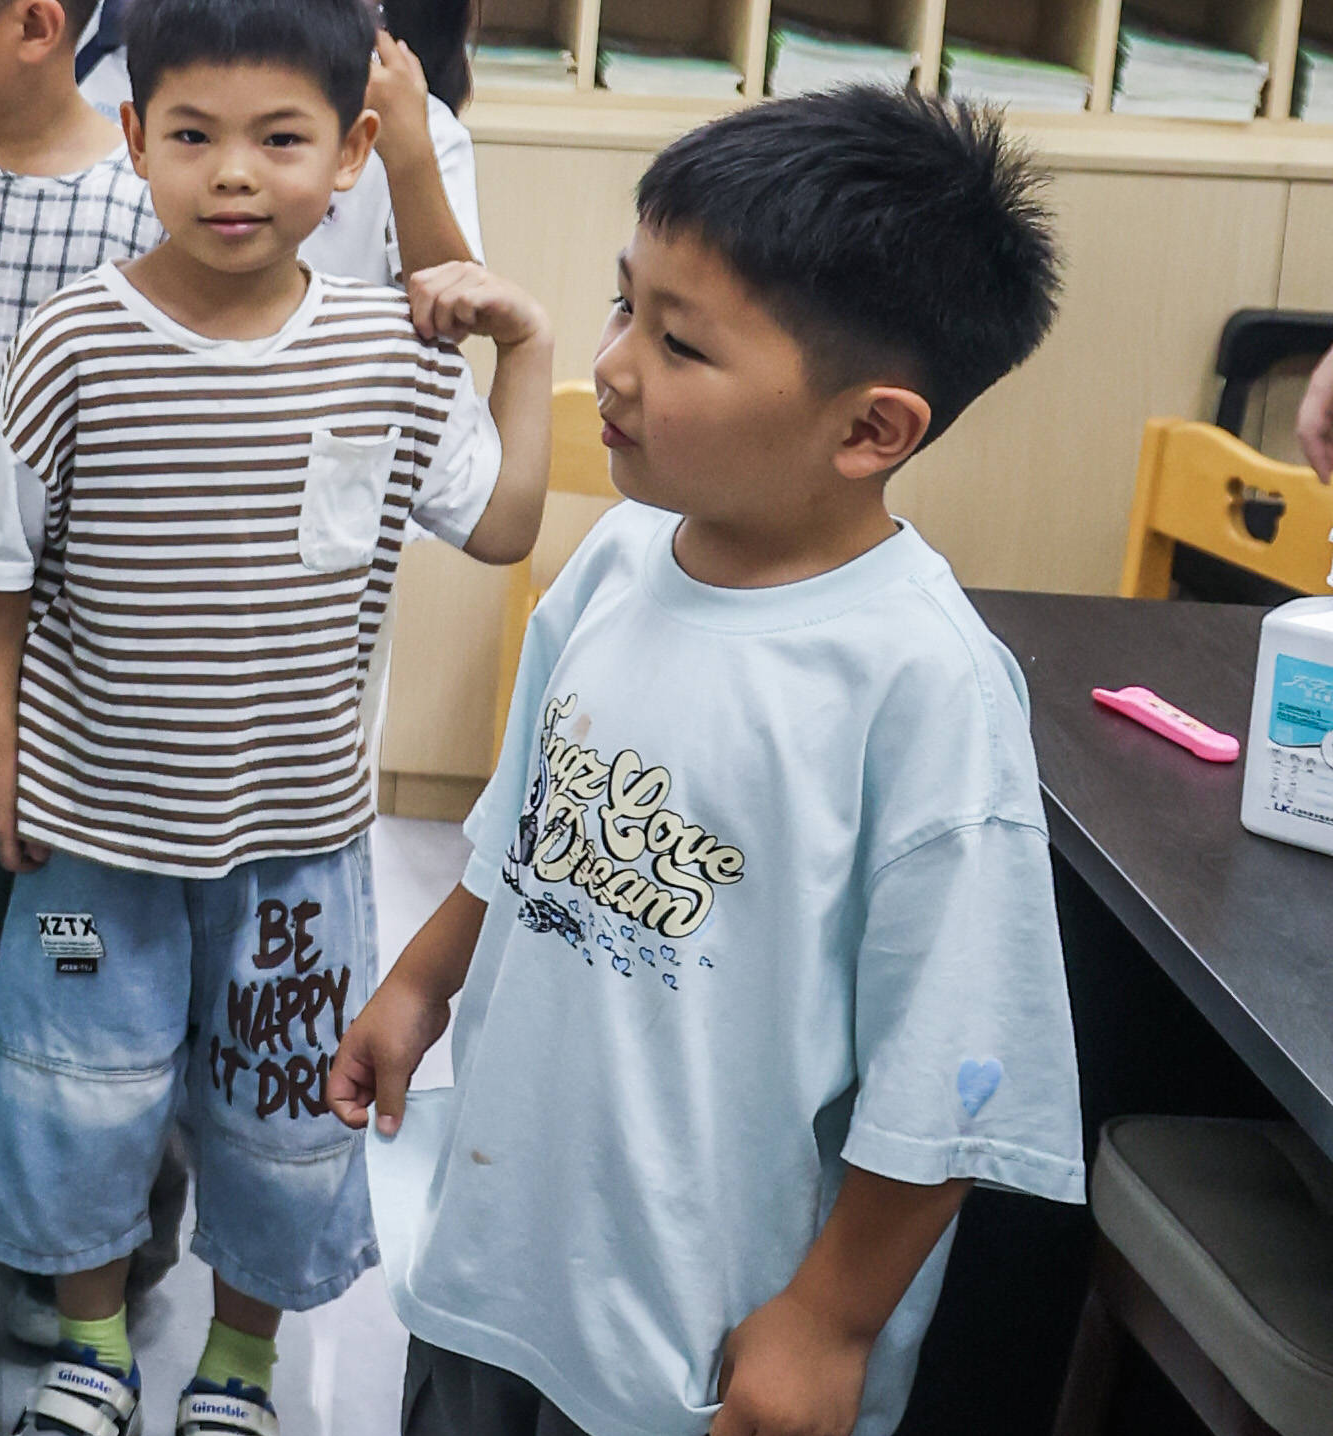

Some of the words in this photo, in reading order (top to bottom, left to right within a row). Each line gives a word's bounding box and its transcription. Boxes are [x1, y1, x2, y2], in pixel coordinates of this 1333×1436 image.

[598, 749, 745, 885] Love
[252, 898, 322, 974] BE
[227, 965, 351, 1055] HAPPY
[255, 1052, 337, 1120] DRI
